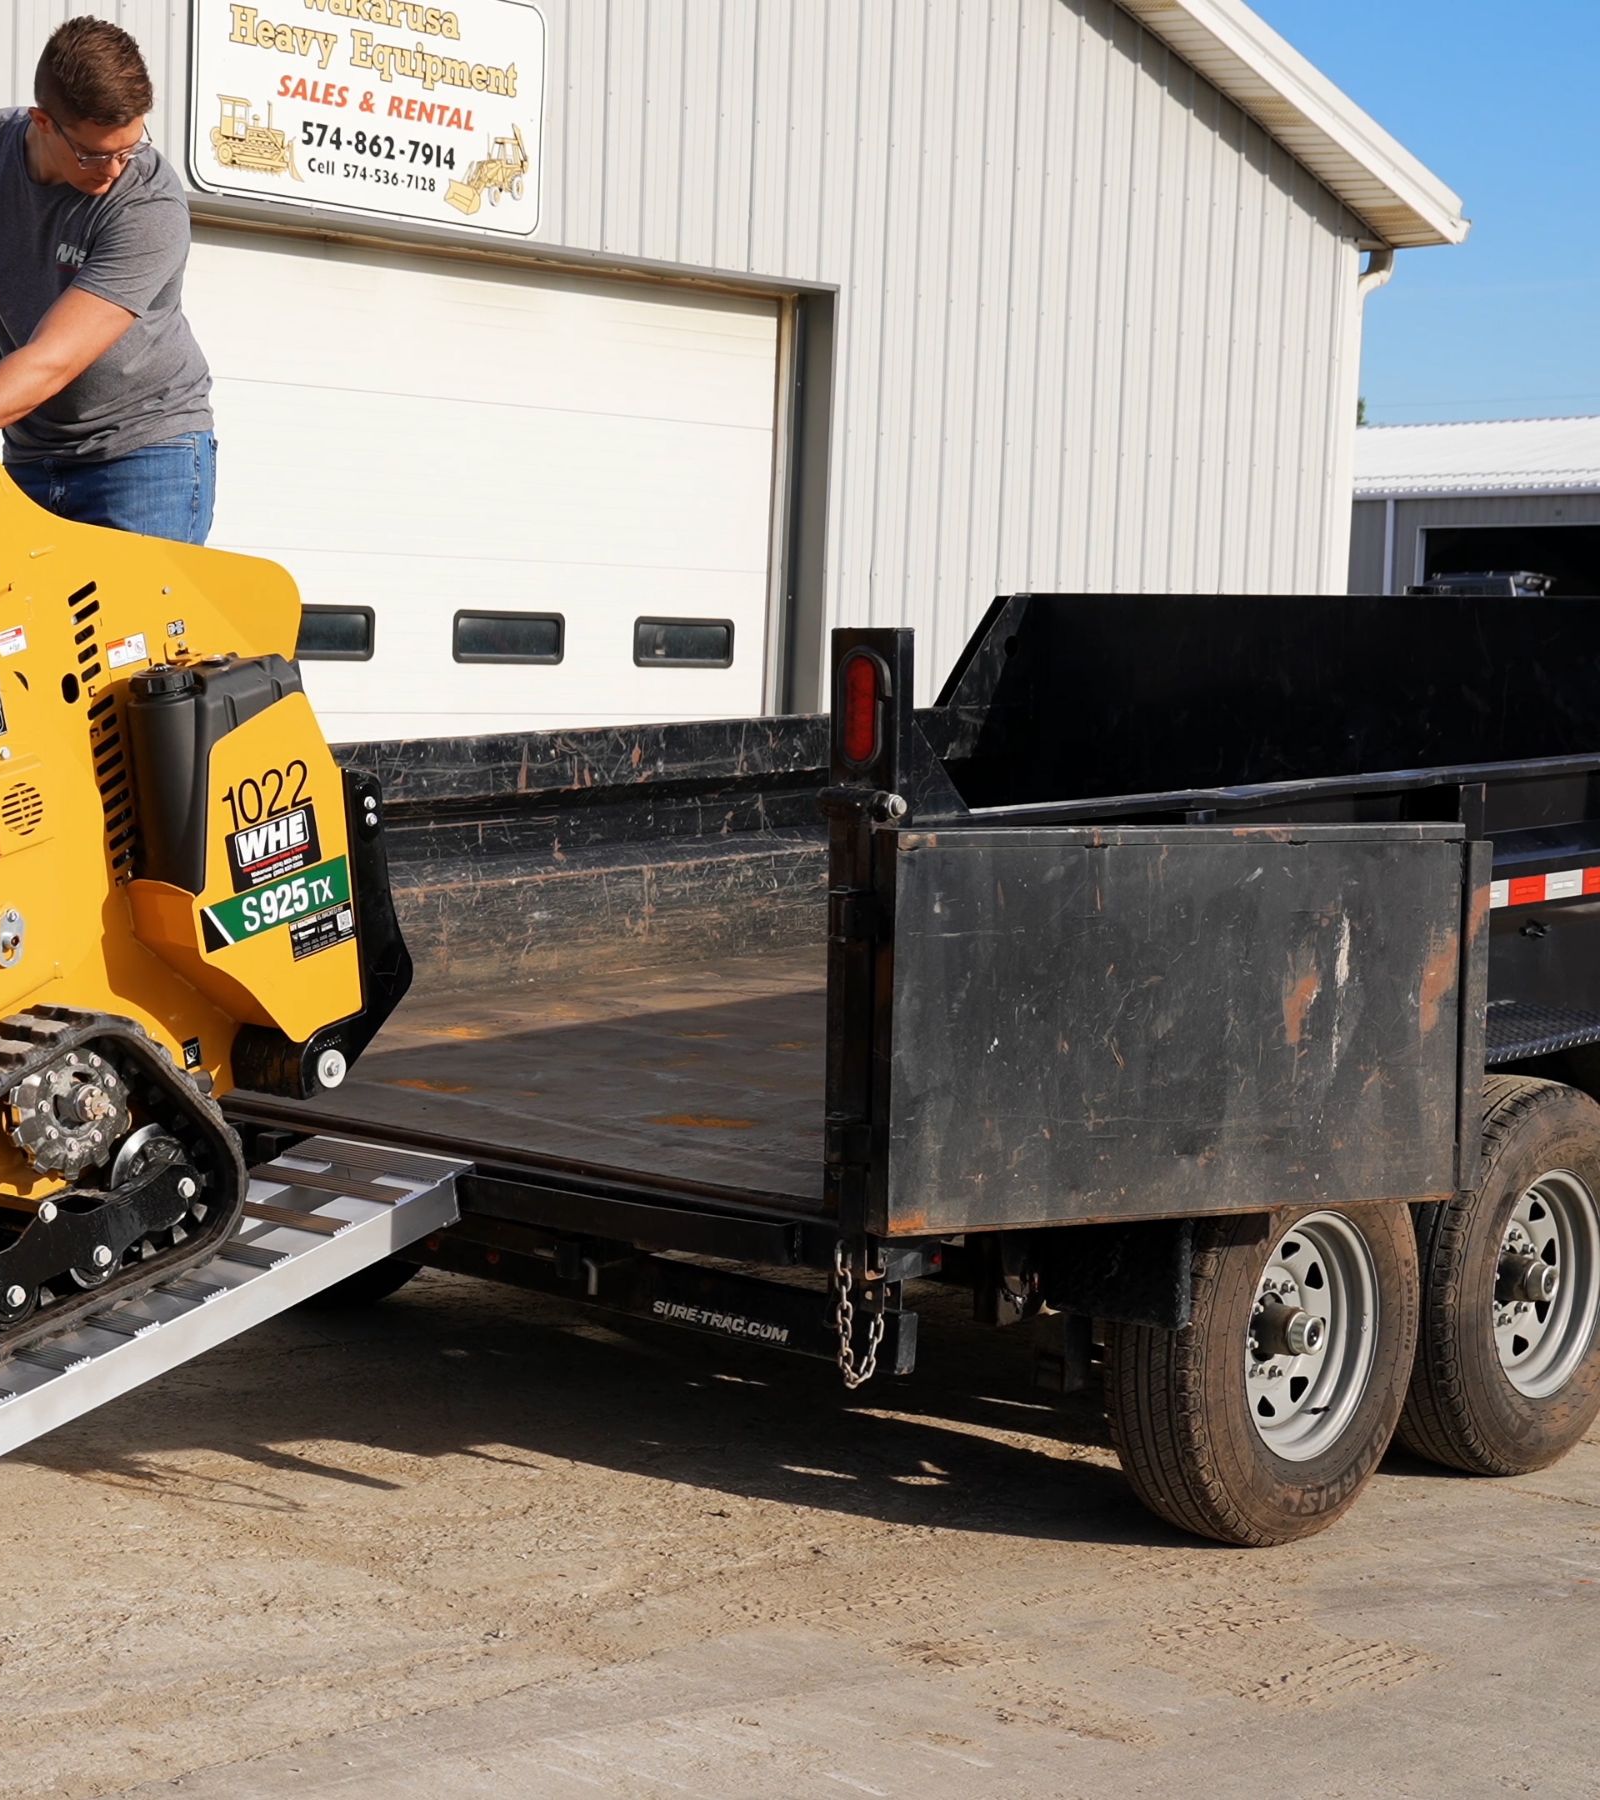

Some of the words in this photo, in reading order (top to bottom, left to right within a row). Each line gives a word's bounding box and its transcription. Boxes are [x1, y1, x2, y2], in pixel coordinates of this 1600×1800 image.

[303, 0, 461, 41] akarusa
[229, 3, 338, 69] Heavy
[350, 28, 518, 98] Equipment
[277, 74, 350, 109] SALES
[358, 91, 376, 114] &
[387, 95, 475, 132] RENTAL
[301, 121, 456, 170] 574-862-7914
[307, 157, 336, 176] Cell
[343, 163, 436, 192] 574-536-7128
[221, 760, 312, 831] 1022
[237, 812, 305, 864] WHE
[652, 1300, 789, 1343] SURE-TRAC.COM
